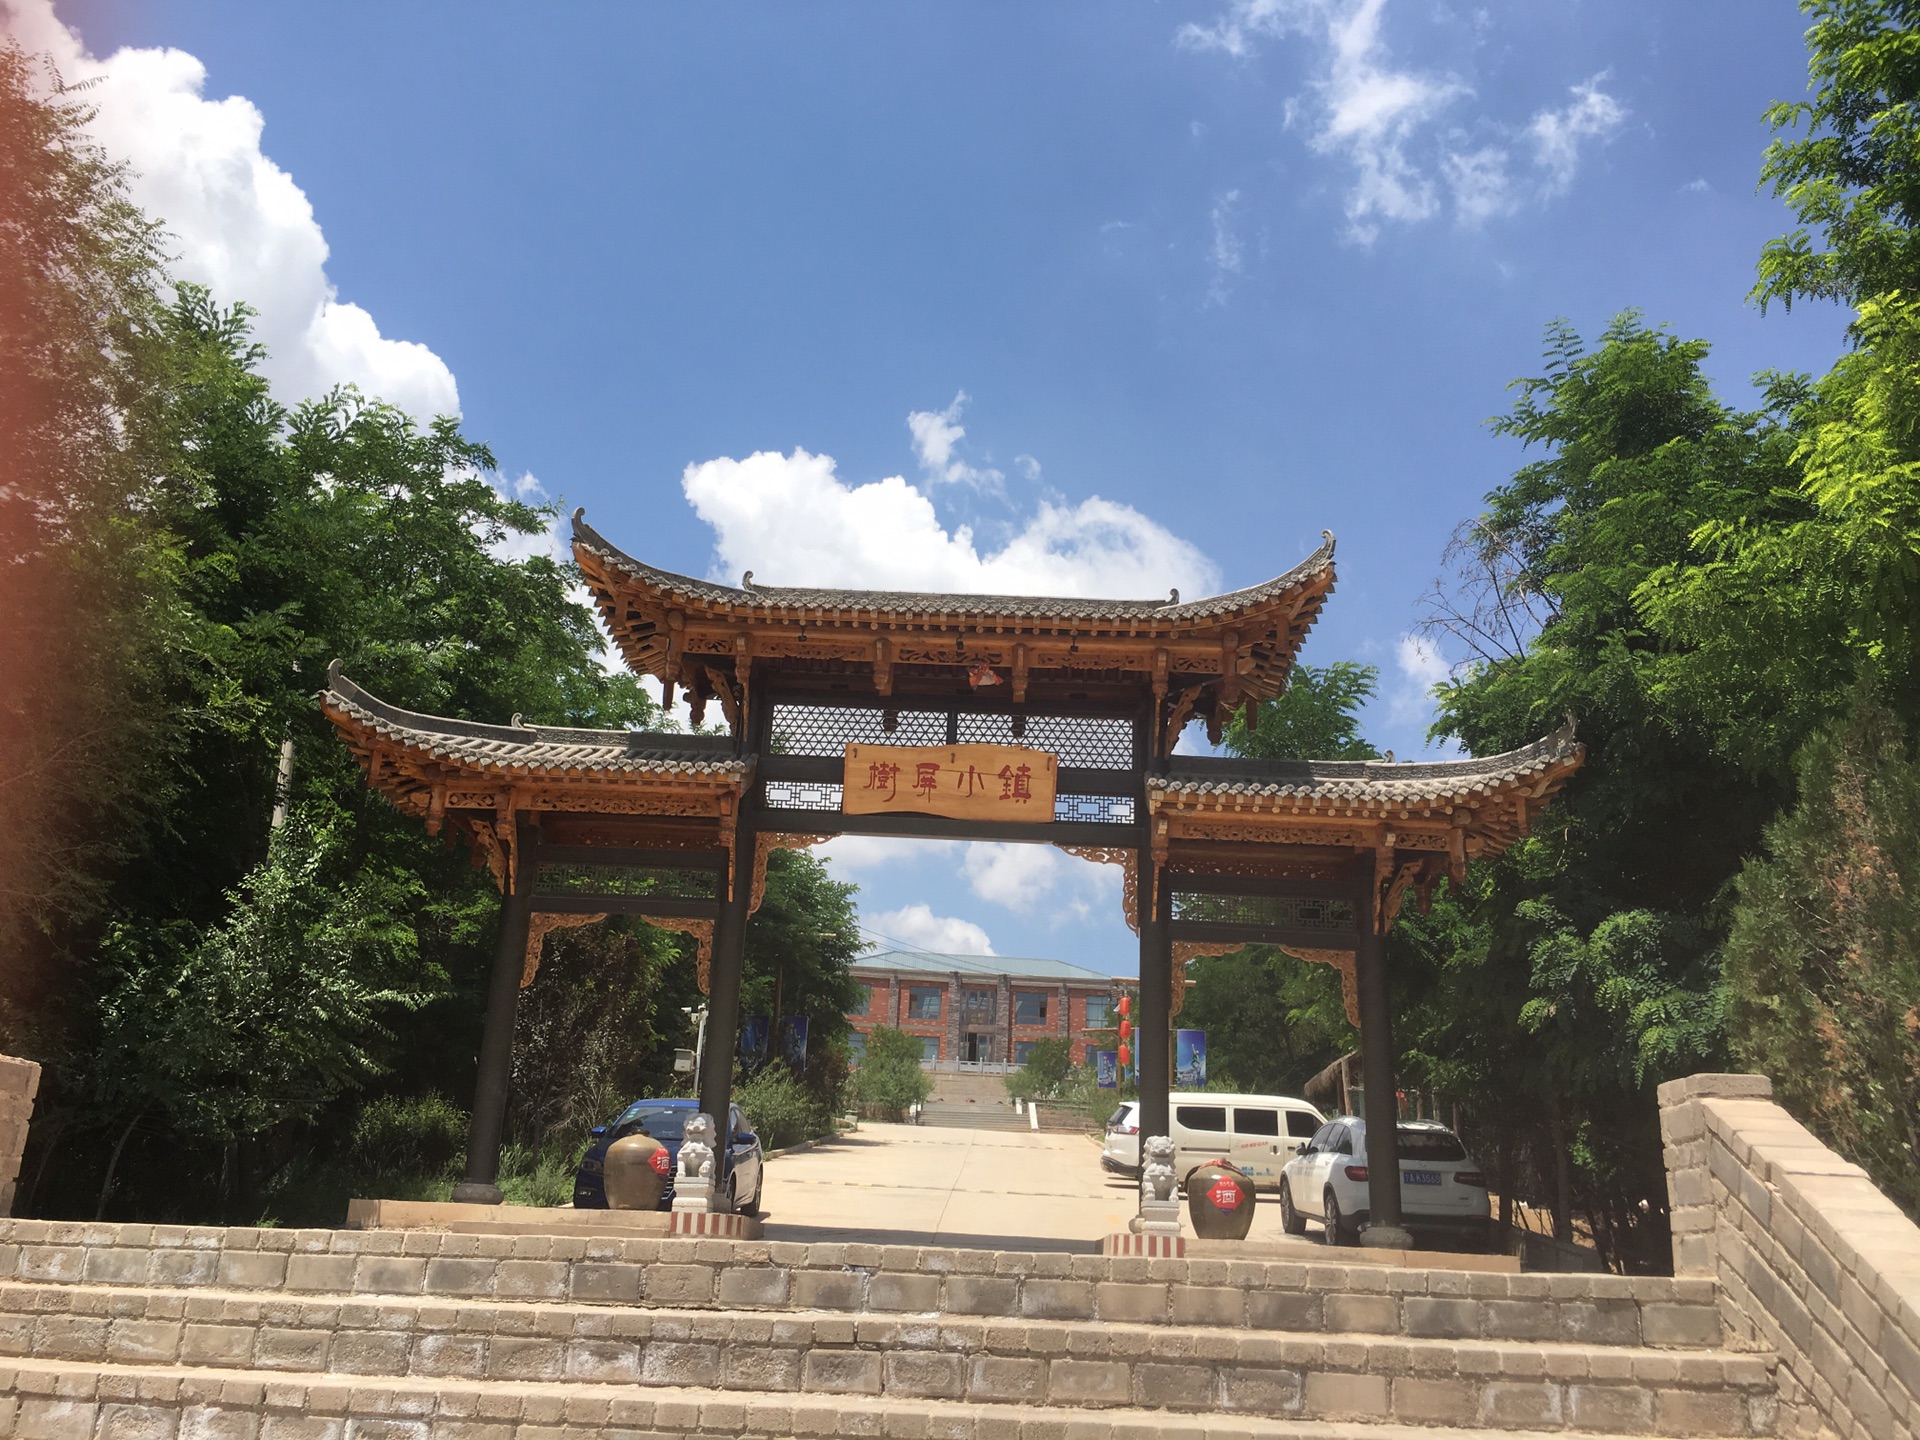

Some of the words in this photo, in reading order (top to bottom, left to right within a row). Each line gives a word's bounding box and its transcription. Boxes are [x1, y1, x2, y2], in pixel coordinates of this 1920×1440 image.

[863, 761, 1032, 804] 樹屏小鎮
[656, 1156, 670, 1170] 酒
[1215, 1189, 1237, 1204] 酒
